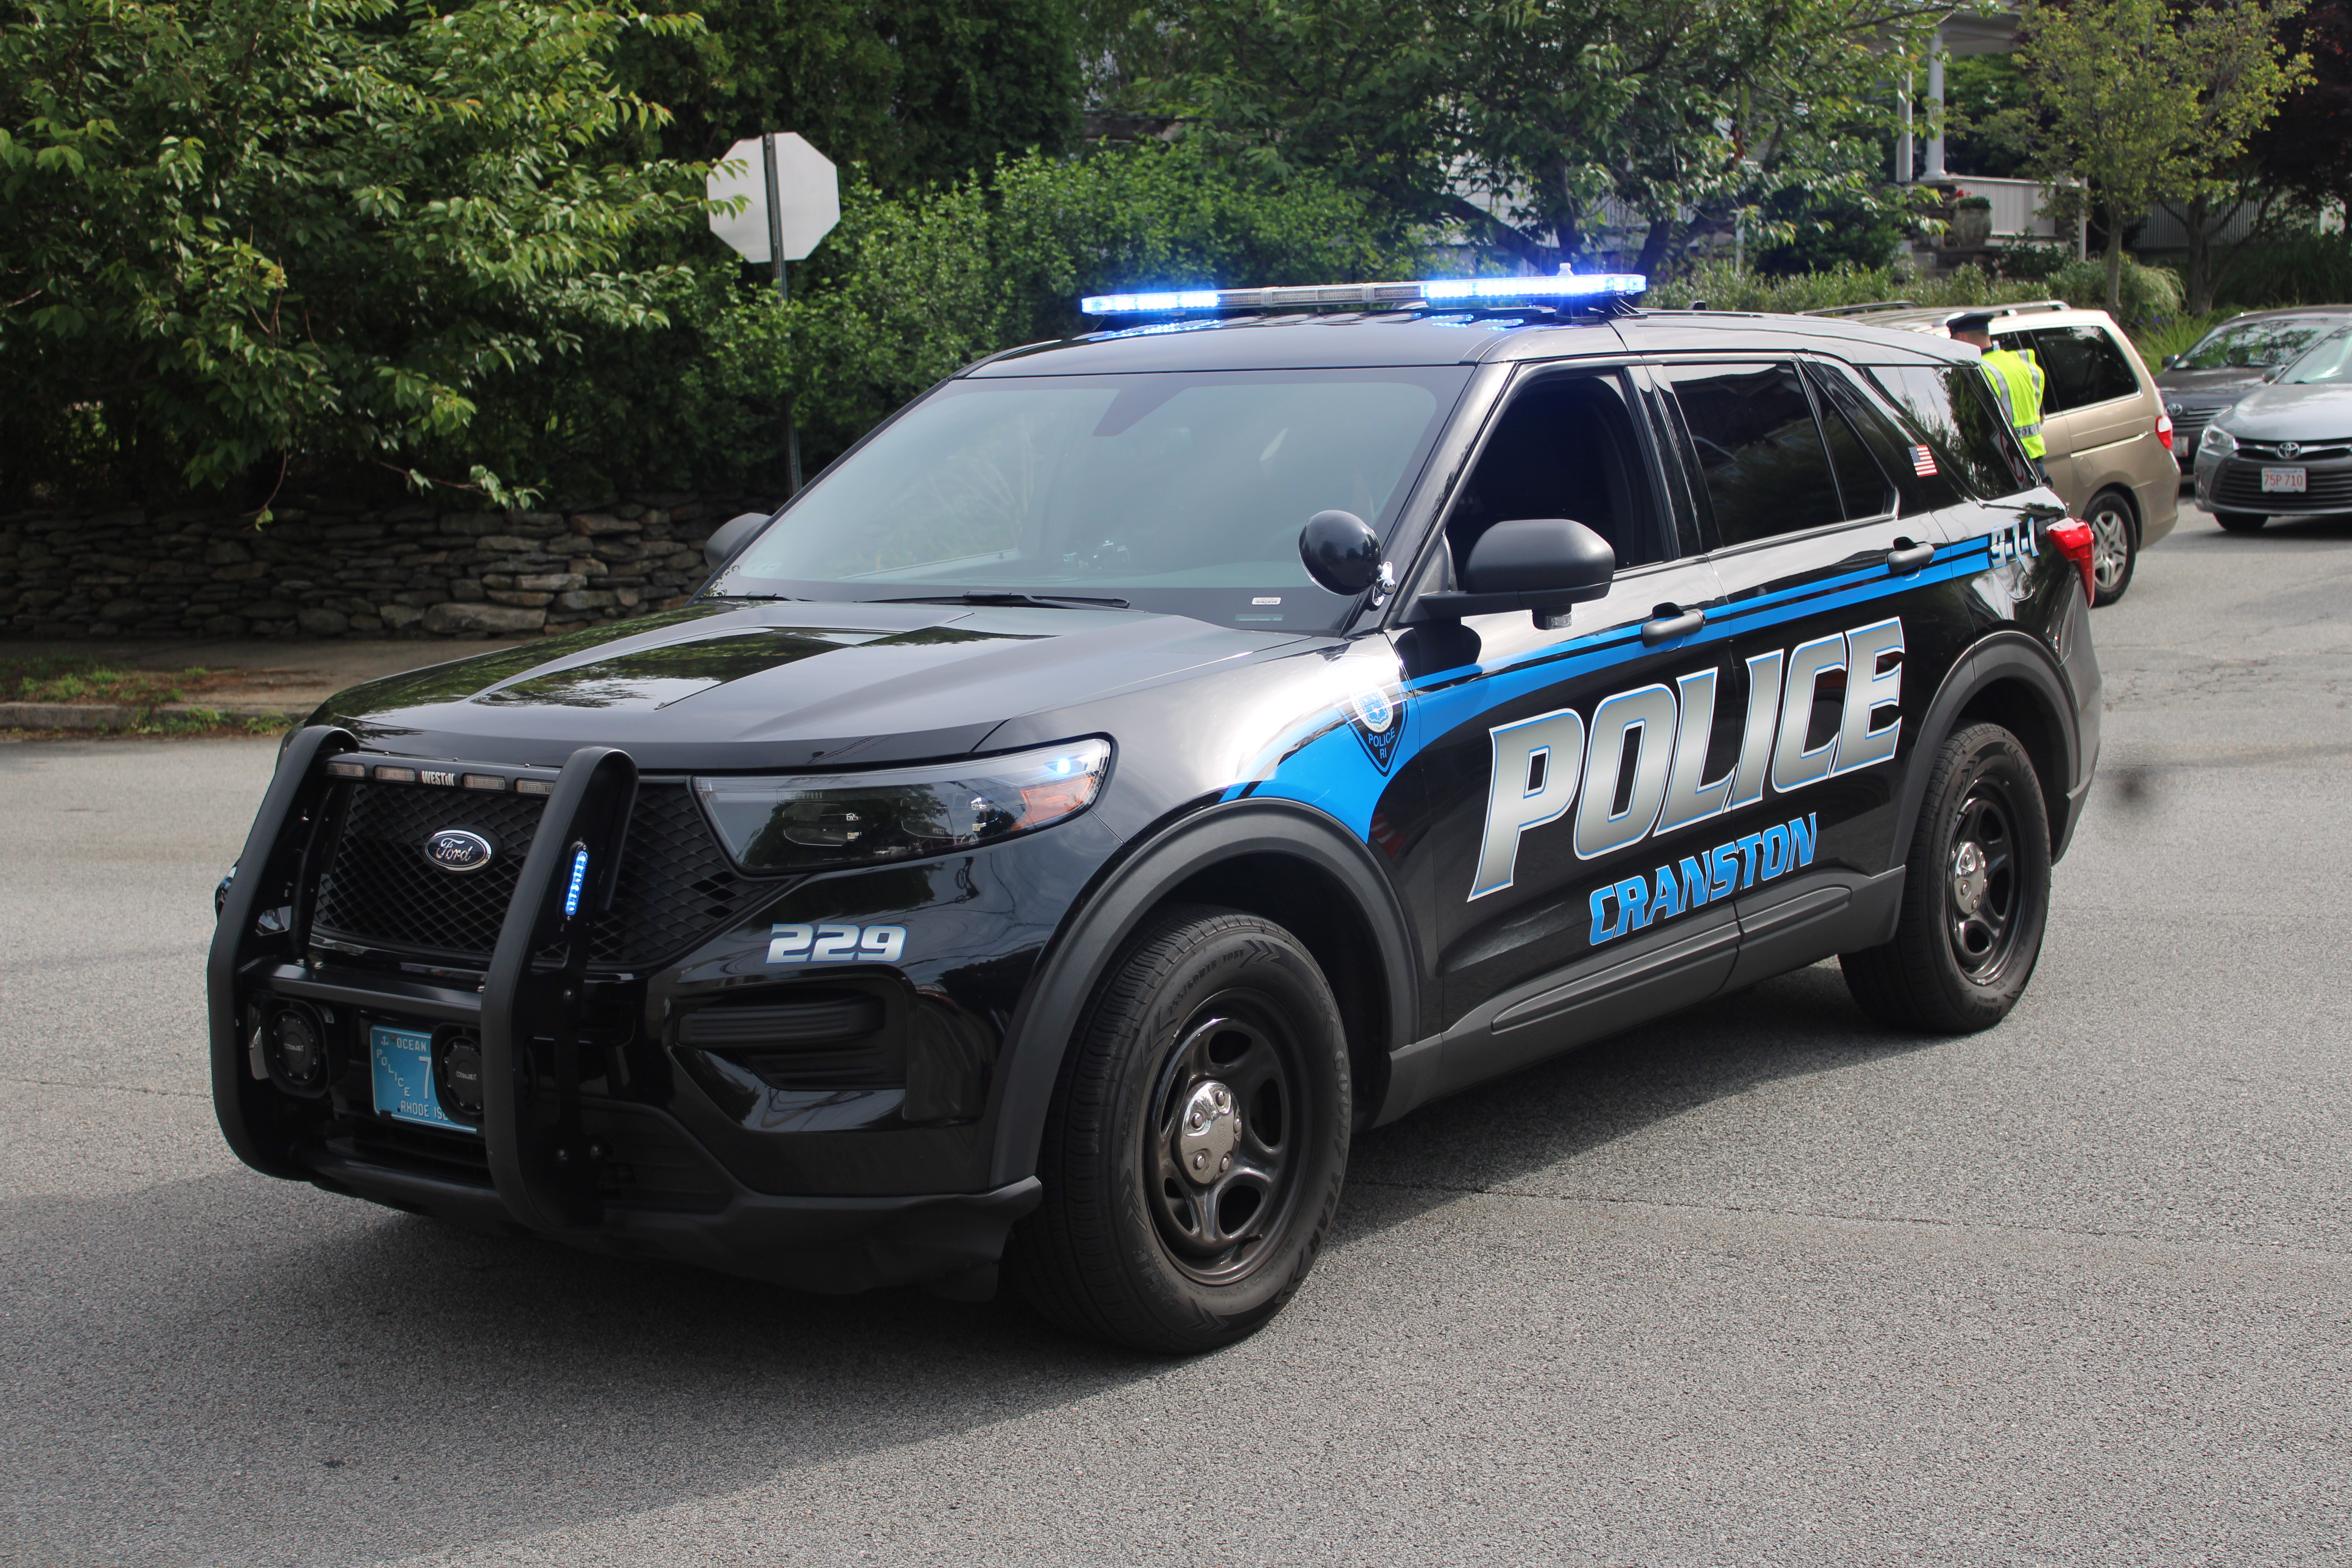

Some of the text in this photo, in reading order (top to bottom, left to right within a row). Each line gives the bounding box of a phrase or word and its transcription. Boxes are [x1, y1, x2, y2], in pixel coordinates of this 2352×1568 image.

[2264, 475, 2303, 486] 75P 710
[1368, 727, 1396, 747] POLICE
[1379, 748, 1387, 759] RI
[1466, 616, 1905, 902] POLICE
[436, 838, 473, 862] Ford
[1589, 812, 1817, 945] CRANSTON
[766, 924, 907, 964] 229
[396, 1038, 427, 1053] OCEAN
[376, 1049, 411, 1097] POLICE
[400, 1101, 429, 1117] RHODE
